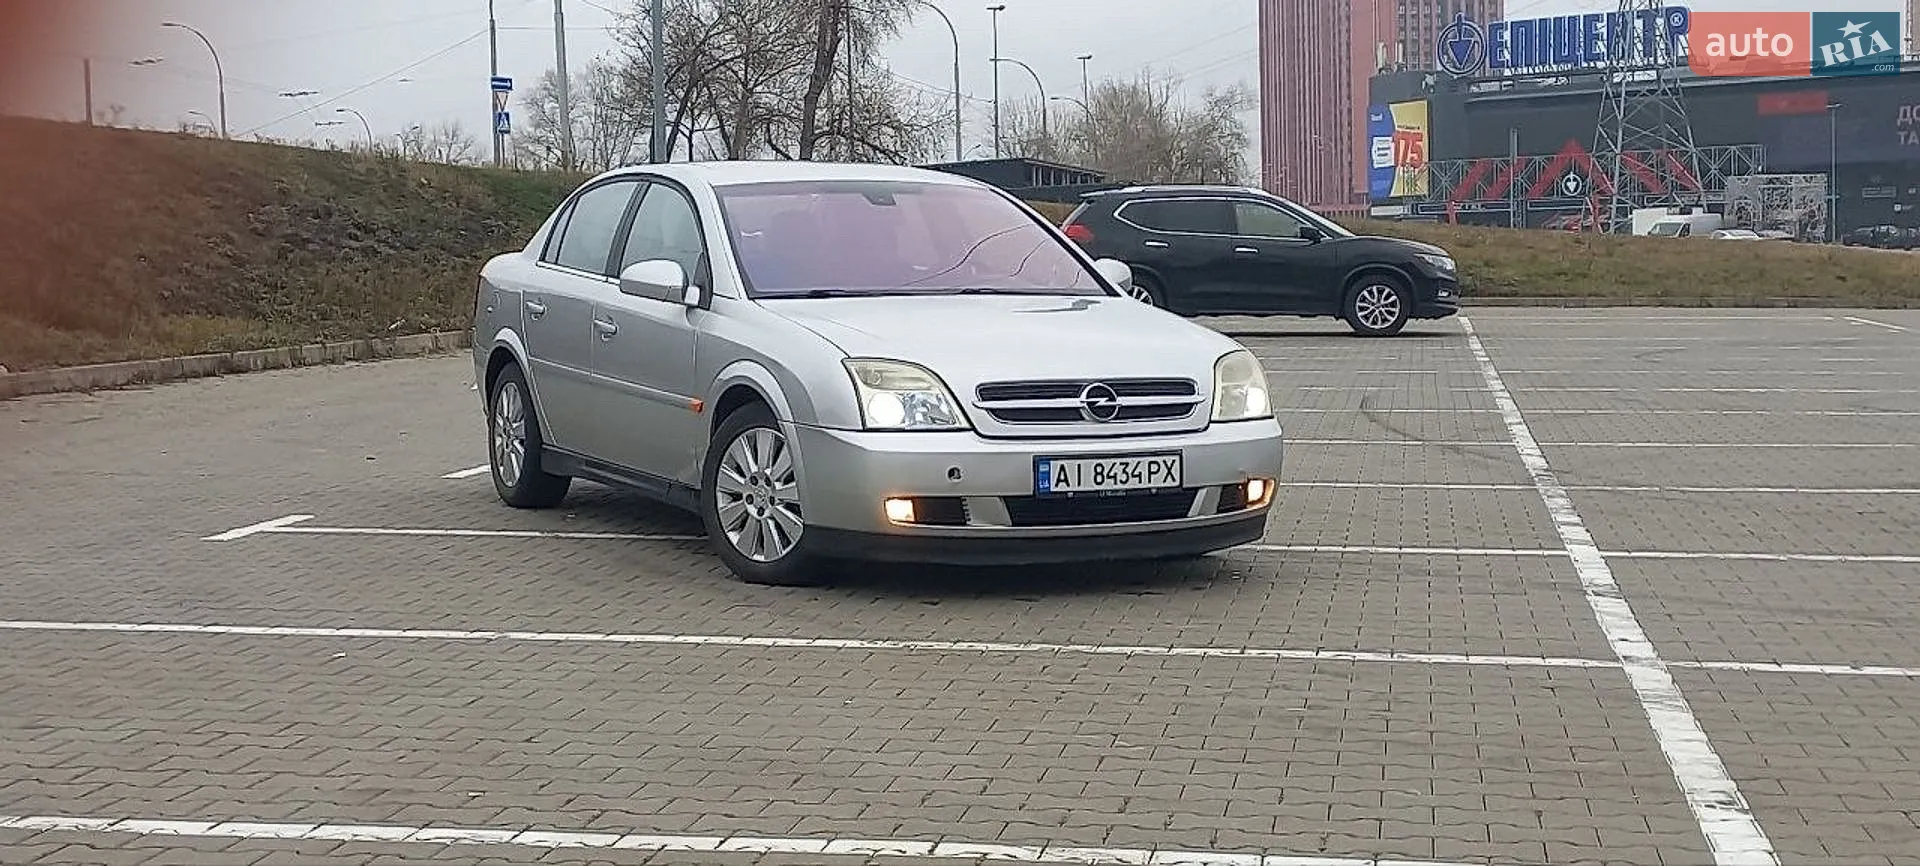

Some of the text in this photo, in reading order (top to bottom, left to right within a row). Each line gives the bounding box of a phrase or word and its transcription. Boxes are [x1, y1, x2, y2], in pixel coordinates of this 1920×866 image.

[1054, 459, 1177, 488] AI 8434 PX
